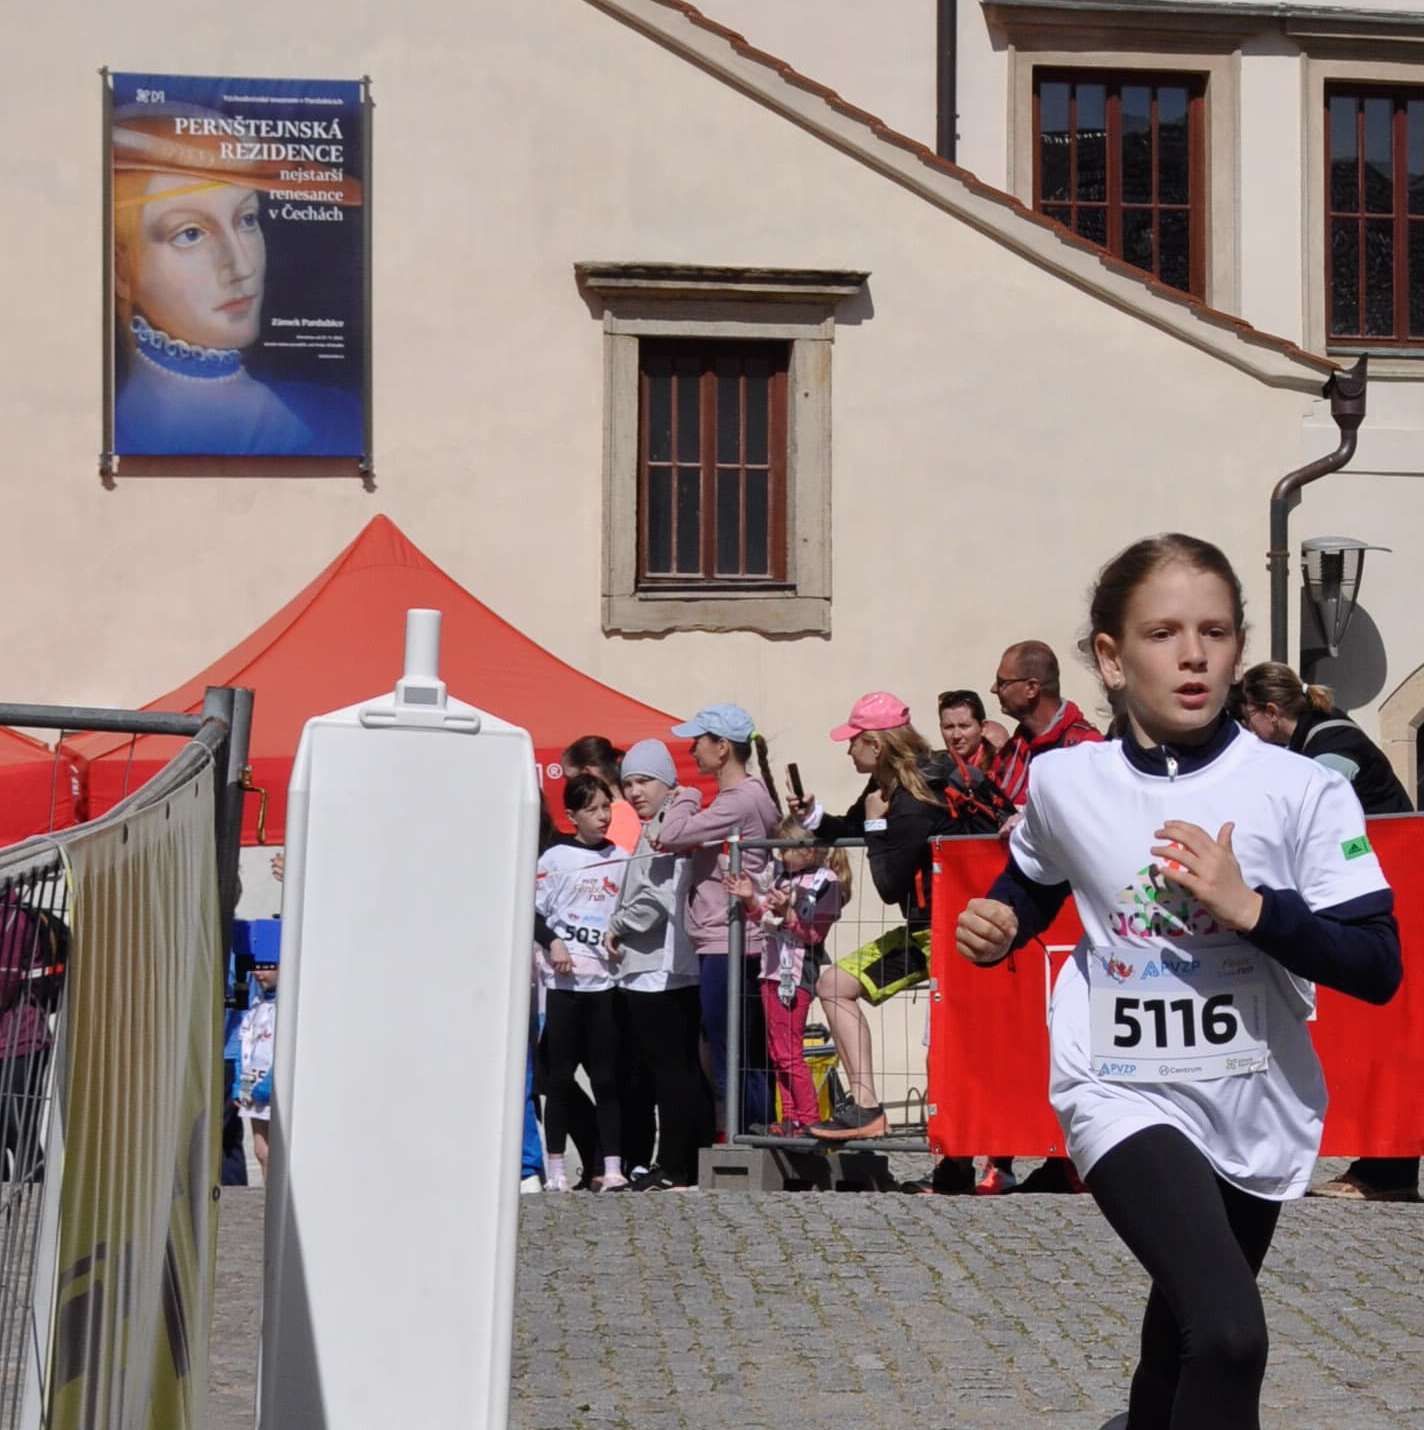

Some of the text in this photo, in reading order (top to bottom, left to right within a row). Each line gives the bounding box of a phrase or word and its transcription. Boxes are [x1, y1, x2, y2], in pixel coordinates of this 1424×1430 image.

[174, 115, 343, 139] PERNŠTEJNSKÁ
[220, 143, 343, 162] REZIDENCE
[280, 167, 343, 183] nejstarší
[269, 189, 343, 202] renesance
[269, 204, 343, 221] v Čechách
[1113, 994, 1238, 1048] 5116
